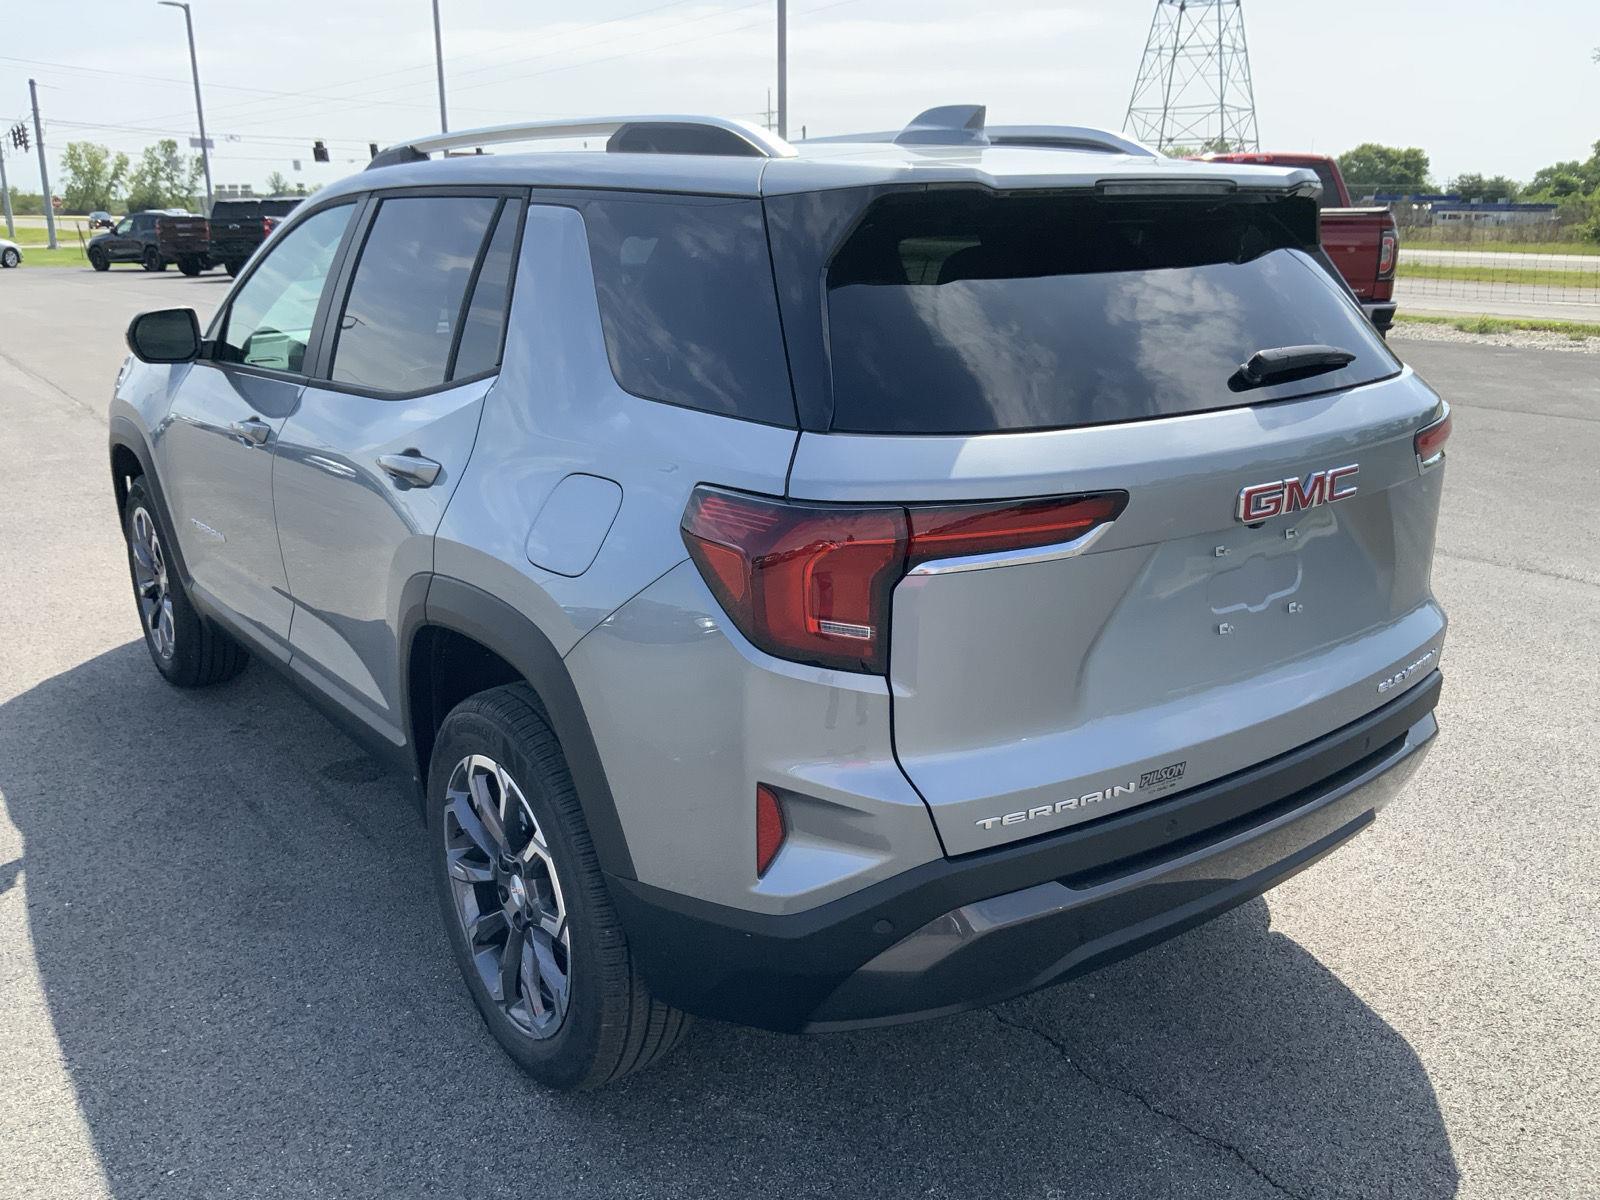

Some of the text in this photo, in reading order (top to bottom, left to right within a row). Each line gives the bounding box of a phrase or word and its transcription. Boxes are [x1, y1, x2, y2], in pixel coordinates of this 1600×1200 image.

[1237, 463, 1360, 524] GMC
[1139, 761, 1187, 789] PILSON
[975, 782, 1136, 830] TERRAIN
